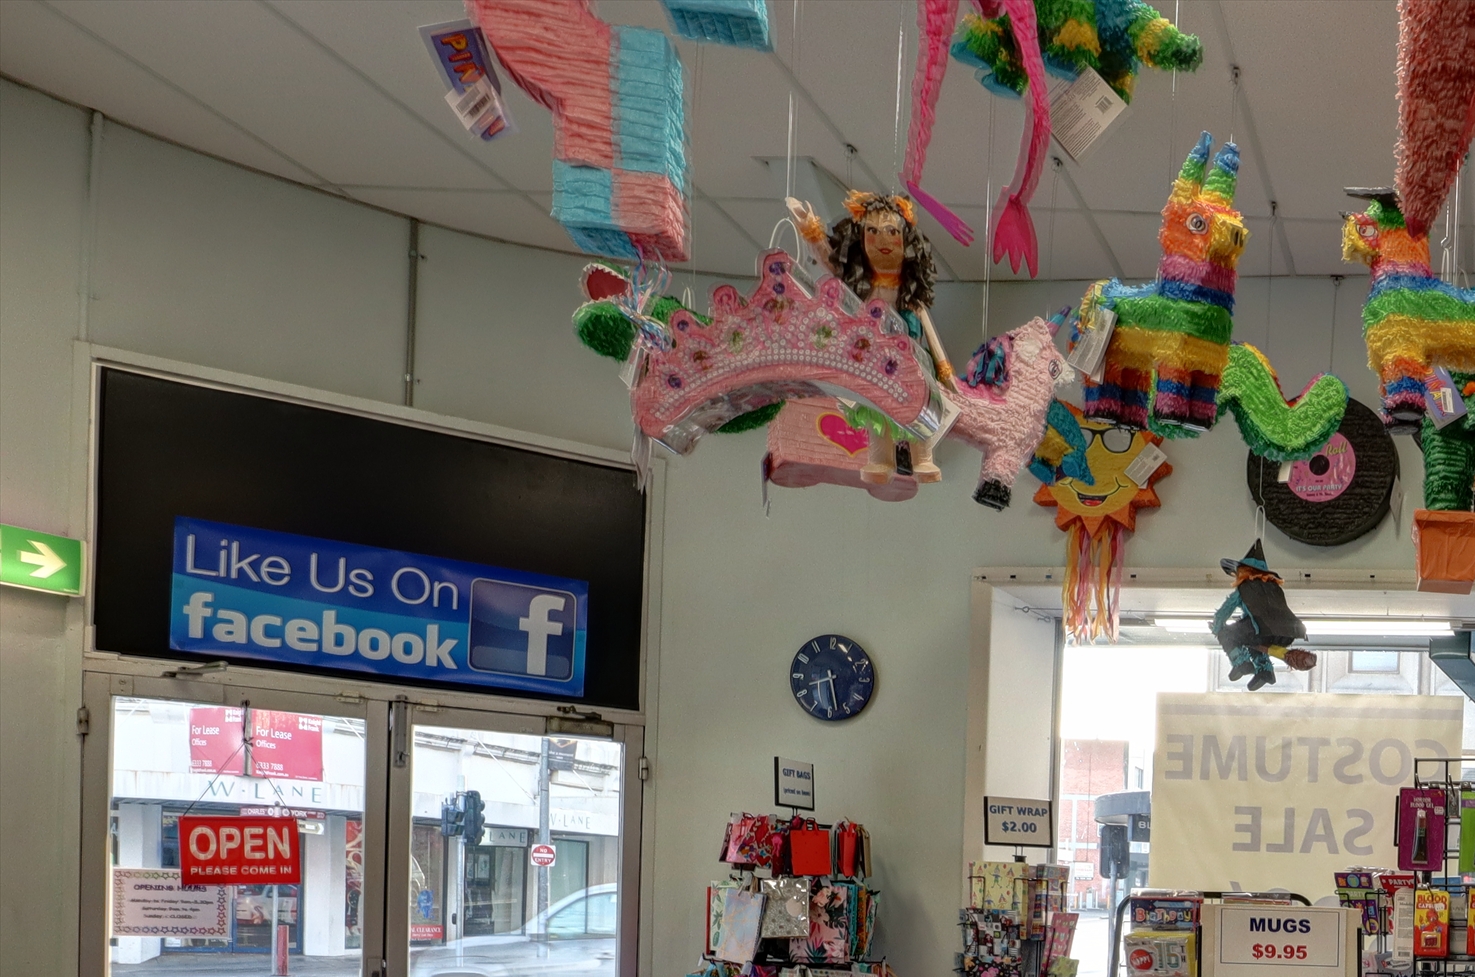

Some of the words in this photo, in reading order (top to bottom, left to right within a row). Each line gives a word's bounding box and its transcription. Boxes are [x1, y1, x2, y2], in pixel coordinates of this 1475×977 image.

[185, 534, 291, 587] Like
[309, 553, 376, 598] Us
[391, 566, 459, 611] On
[182, 591, 459, 671] facebook
[192, 725, 202, 735] For
[203, 726, 220, 735] Lease
[256, 726, 269, 737] For
[271, 728, 292, 740] Lease
[256, 740, 276, 749] Offices
[989, 804, 1014, 815] GIFT
[1017, 806, 1048, 817] WRAP
[1001, 821, 1037, 833] $2.00
[189, 825, 291, 861] OPEN
[190, 866, 237, 876] PLEASE
[241, 867, 276, 875] COME
[280, 866, 292, 875] IN
[134, 884, 174, 892] OPENING
[1418, 894, 1447, 903] BLOOD
[1250, 916, 1311, 934] MUGS
[1252, 943, 1308, 960] $9.95
